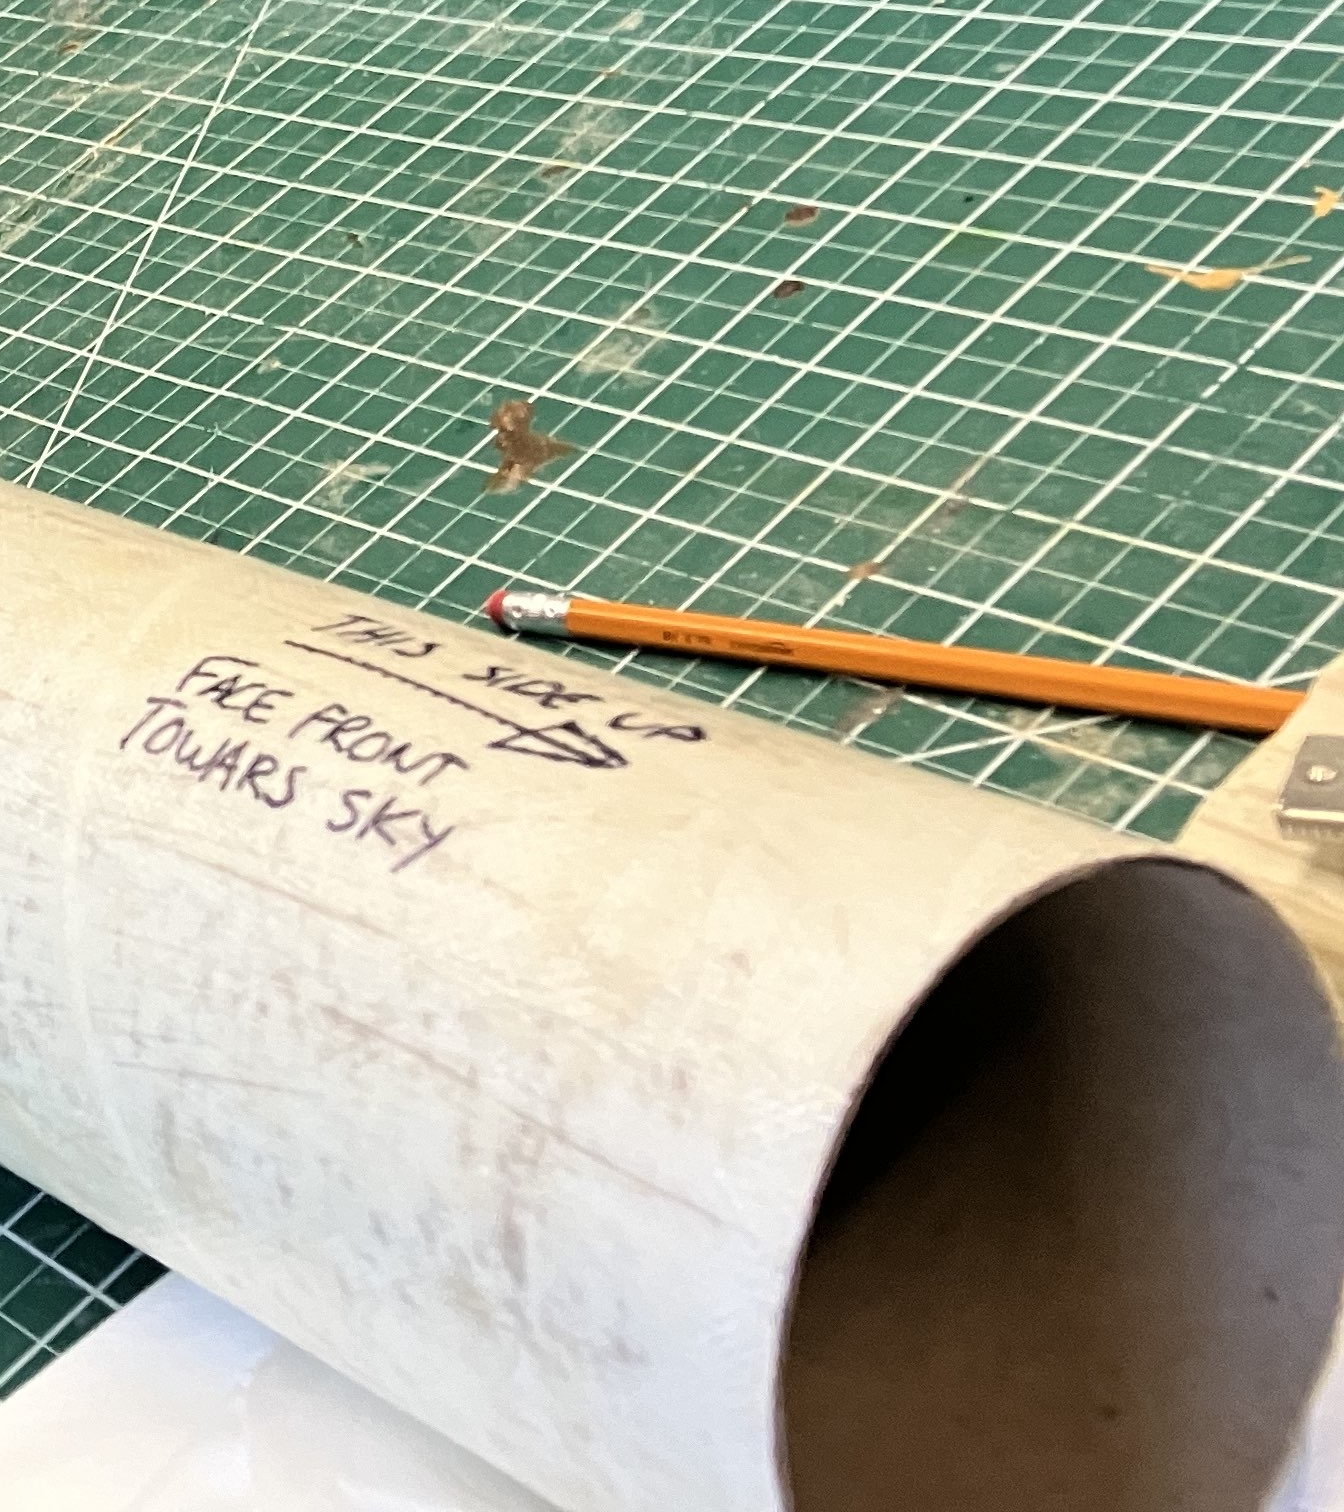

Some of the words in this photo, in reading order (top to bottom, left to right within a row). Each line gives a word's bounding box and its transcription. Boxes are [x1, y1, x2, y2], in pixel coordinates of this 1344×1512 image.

[174, 655, 295, 724] FACE
[291, 702, 472, 784] FRONT
[312, 614, 437, 658] THIS
[463, 663, 603, 710] SIDE
[604, 711, 707, 743] UP
[118, 696, 307, 809] TOWARS
[324, 789, 459, 873] SKY
